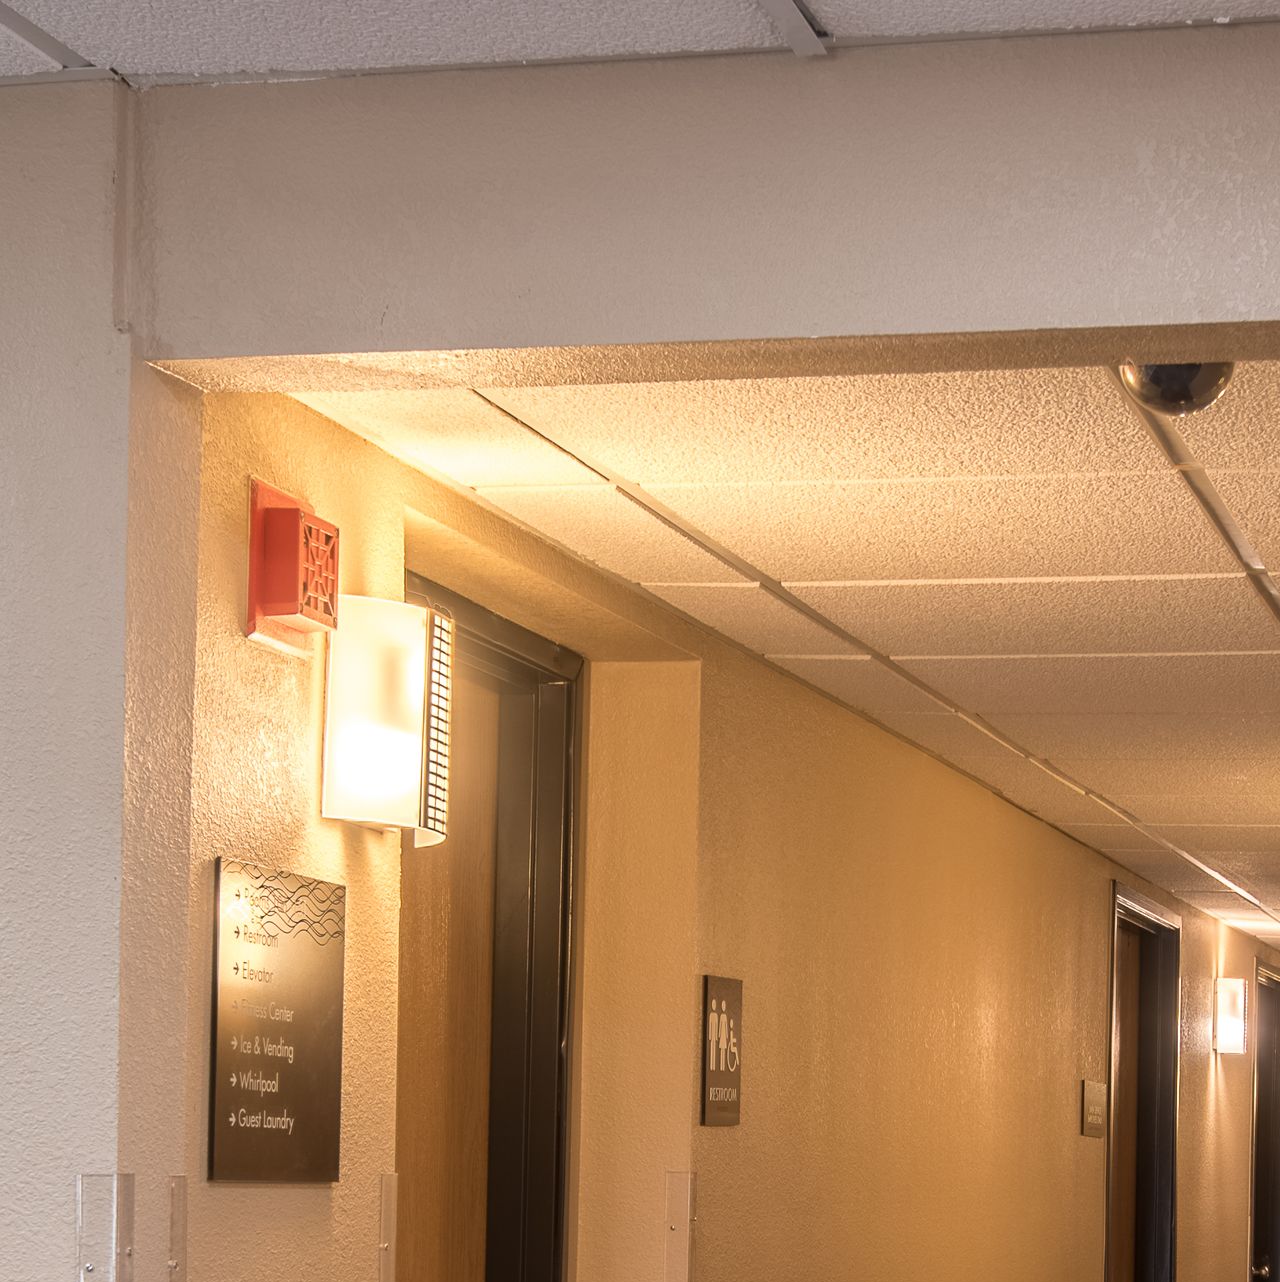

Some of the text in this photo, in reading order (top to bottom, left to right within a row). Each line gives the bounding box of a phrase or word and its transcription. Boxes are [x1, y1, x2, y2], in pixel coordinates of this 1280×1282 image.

[243, 924, 279, 948] Restroom
[242, 959, 274, 984] Elevator
[268, 1001, 294, 1022] Center
[240, 1034, 294, 1064] Ice & Vending
[239, 1069, 279, 1097] Whirlpool
[709, 1087, 737, 1101] RESTROOM
[238, 1107, 295, 1135] Guest Laundry
